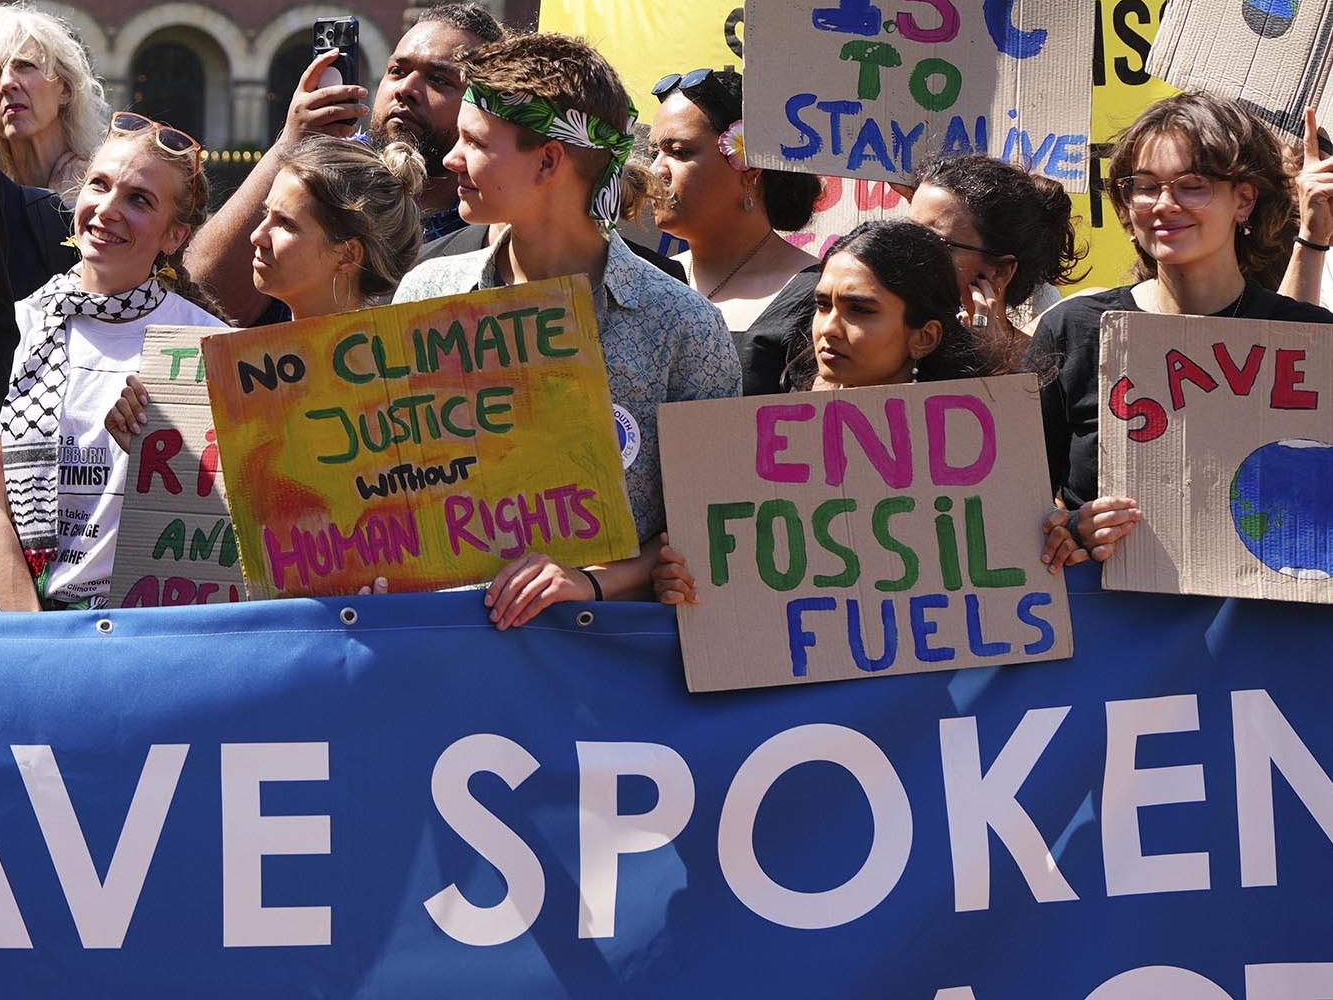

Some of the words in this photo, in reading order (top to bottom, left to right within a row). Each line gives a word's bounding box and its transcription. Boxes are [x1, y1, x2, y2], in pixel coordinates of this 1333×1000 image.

[839, 40, 963, 112] TO
[781, 93, 924, 173] STAY
[237, 353, 305, 393] NO
[332, 307, 578, 384] CLIMATE
[1109, 342, 1318, 442] SAVE
[305, 387, 514, 464] JUSTICE
[756, 394, 997, 489] END
[263, 511, 420, 590] HUMAN
[445, 484, 600, 559] RIGHTS
[787, 592, 1054, 677] FUELS
